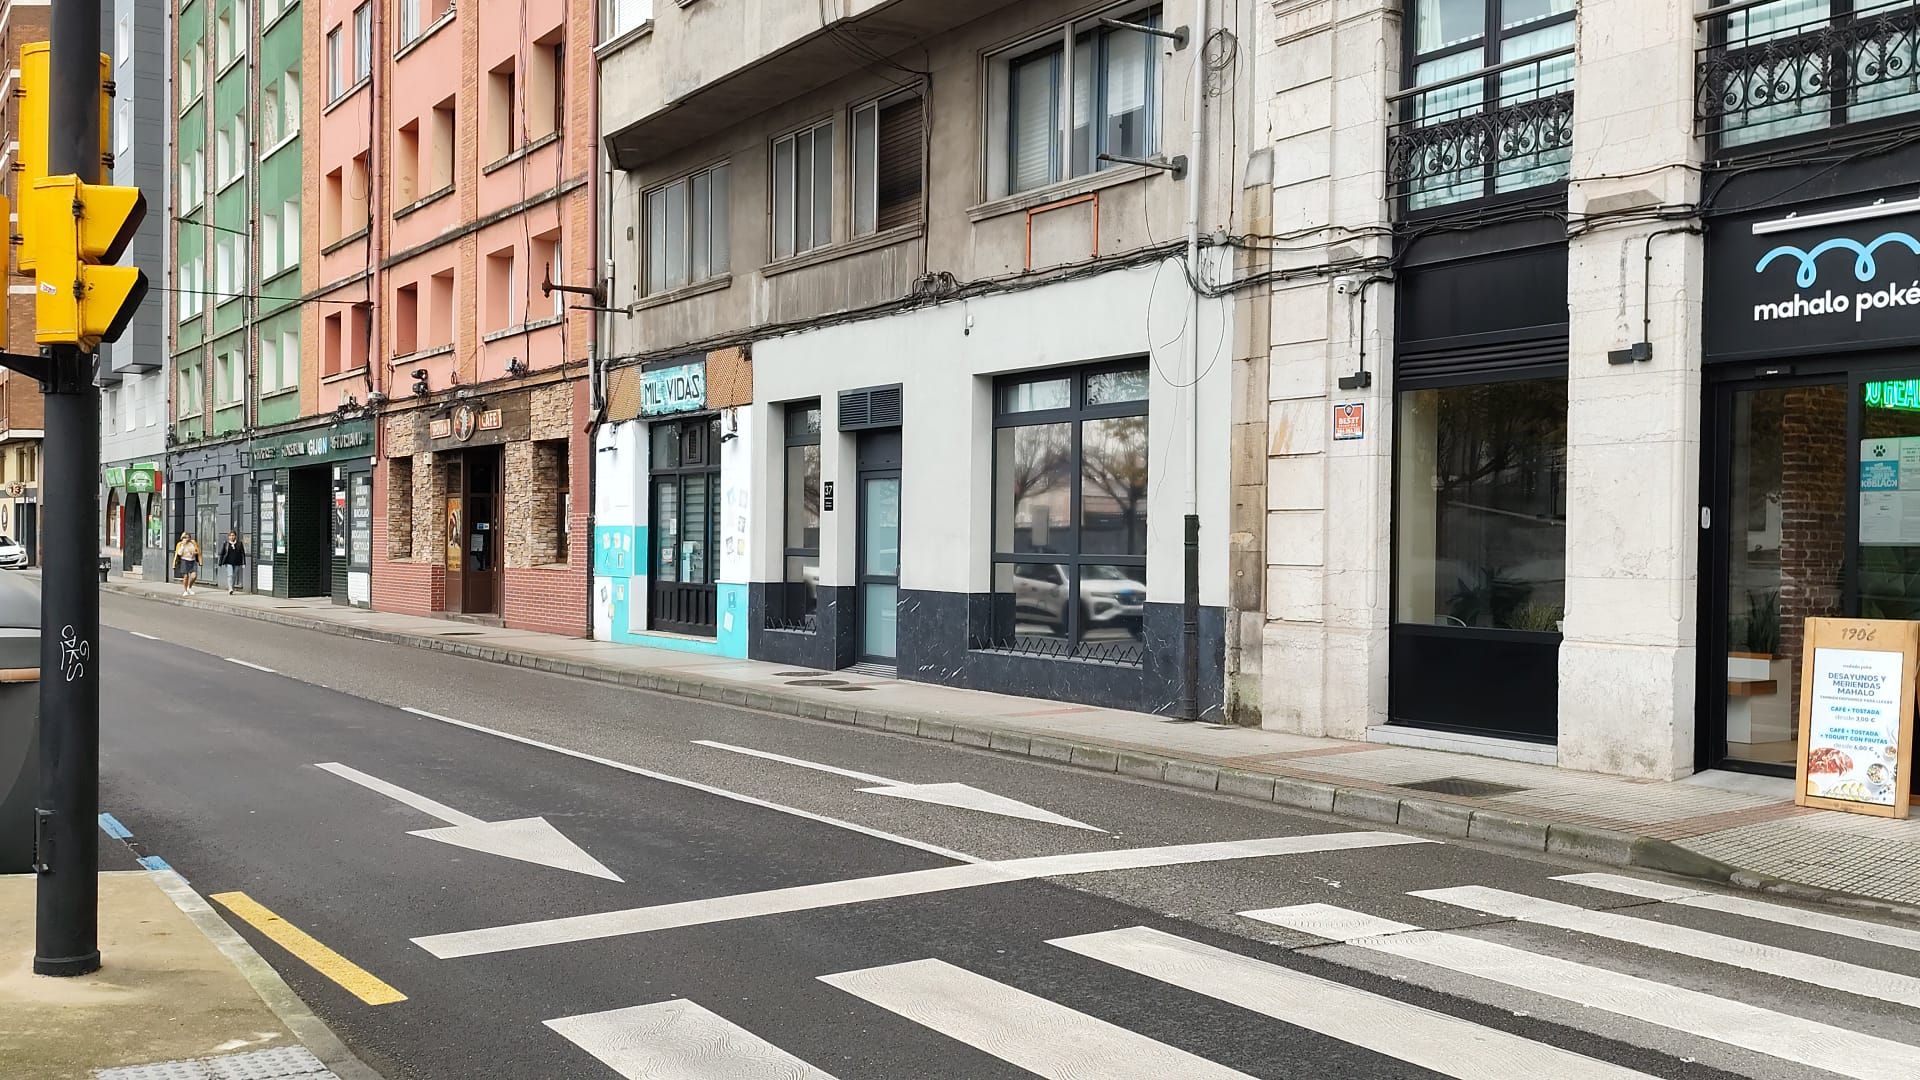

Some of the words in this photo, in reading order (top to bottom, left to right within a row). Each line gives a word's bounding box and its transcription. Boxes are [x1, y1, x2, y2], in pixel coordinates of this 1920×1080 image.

[1754, 290, 1850, 321] mahalo
[1855, 280, 1920, 322] poké
[644, 381, 661, 406] MIL
[666, 374, 700, 402] VIDAS
[824, 485, 833, 495] 37
[1841, 627, 1876, 642] 1906
[1828, 672, 1879, 682] DESAYUNOS
[1880, 675, 1887, 683] Y
[1832, 680, 1881, 690] MERIENDAS
[1837, 688, 1875, 697] MAHALO
[1852, 707, 1880, 715] TOSTADA
[1851, 728, 1879, 737] TOSTADA
[1824, 733, 1849, 741] YOGURT
[1864, 737, 1888, 745] FRUTAS
